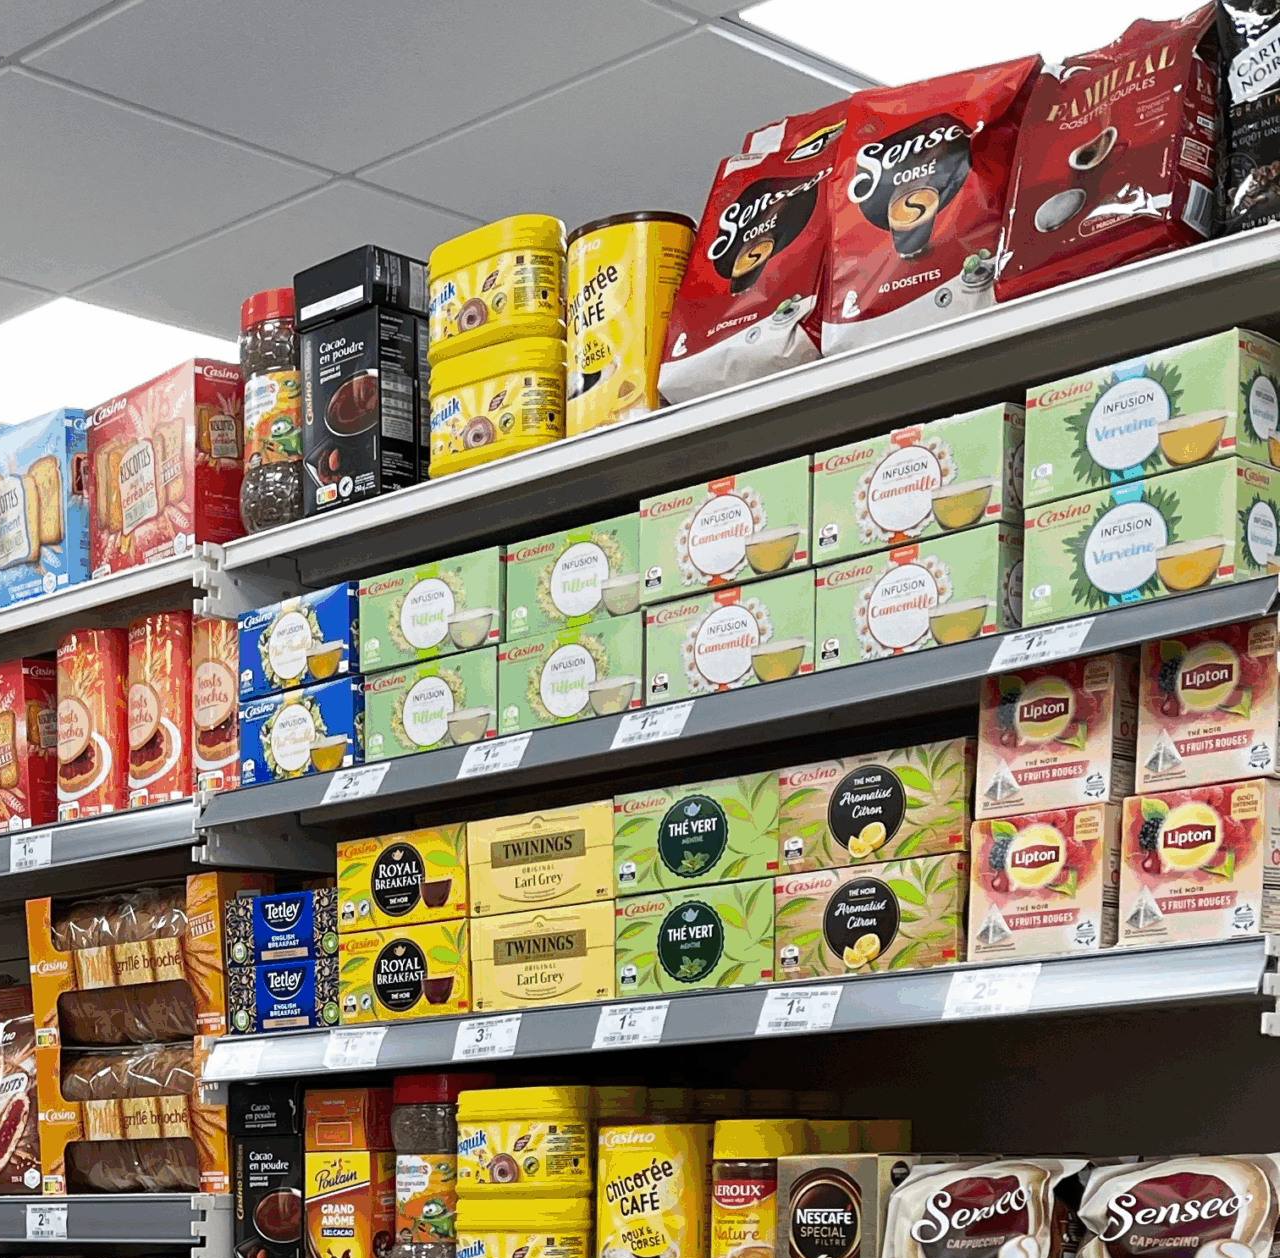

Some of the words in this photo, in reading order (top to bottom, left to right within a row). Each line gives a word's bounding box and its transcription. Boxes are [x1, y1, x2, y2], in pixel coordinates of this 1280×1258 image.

[1046, 45, 1175, 122] FAMILIAL
[1060, 104, 1109, 130] DOSETTES
[1110, 77, 1156, 105] SOUPLES
[893, 159, 936, 186] CORSÉ
[742, 216, 777, 243] CORSÉ
[878, 280, 891, 295] 40
[892, 268, 941, 291] DOSETTES
[204, 366, 238, 380] Casino
[1039, 381, 1093, 407] Casino
[1103, 392, 1154, 414] INFUSION
[1095, 417, 1157, 441] Verveine
[120, 445, 151, 483] BISCOTTES
[882, 461, 928, 480] INFUSION
[649, 495, 693, 518] Casino
[700, 509, 742, 526] INFUSION
[691, 522, 750, 548] Camomille
[1101, 518, 1152, 537] INFUSION
[561, 554, 598, 571] INFUSION
[881, 579, 925, 598] INFUSION
[243, 612, 273, 630] Casino
[697, 634, 756, 657] Camomille
[1185, 667, 1228, 686] Lipton
[1023, 701, 1064, 719] Lipton
[789, 767, 837, 786] Casino
[839, 787, 893, 806] Aromatisé
[852, 804, 882, 818] Citron
[668, 820, 687, 837] THÉ
[690, 817, 717, 835] VERT
[1167, 829, 1211, 846] Lipton
[503, 837, 572, 860] TWININGS
[378, 864, 419, 877] ROYAL
[521, 864, 554, 875] ORIGINAL
[375, 875, 421, 889] BREAKFAST
[515, 874, 535, 889] Earl
[537, 870, 563, 887] Grey
[265, 901, 301, 922] Tetley
[1162, 901, 1166, 912] 5
[1168, 898, 1196, 911] FRUITS
[1197, 895, 1231, 908] ROUGES
[268, 939, 299, 948] BREAKFAST
[36, 960, 69, 973] Casino
[116, 956, 141, 973] grillé
[144, 949, 180, 969] brioché
[268, 970, 302, 990] Tetley
[249, 1151, 273, 1161] Cacao
[249, 1161, 259, 1170] en
[261, 1160, 289, 1171] poudre
[315, 1168, 358, 1191] Poulain
[605, 1158, 675, 1203] Chicorée
[321, 1203, 354, 1215] GRAND
[619, 1191, 660, 1217] CAFÉ
[322, 1214, 354, 1226] ARÔME
[795, 1208, 852, 1225] NESCAFÉ
[1098, 1194, 1252, 1241] Senseo
[715, 1227, 760, 1242] Nature
[800, 1225, 846, 1239] SPECIAL
[815, 1239, 846, 1247] FILTRE
[946, 1237, 1005, 1248] CAPPUCCINO
